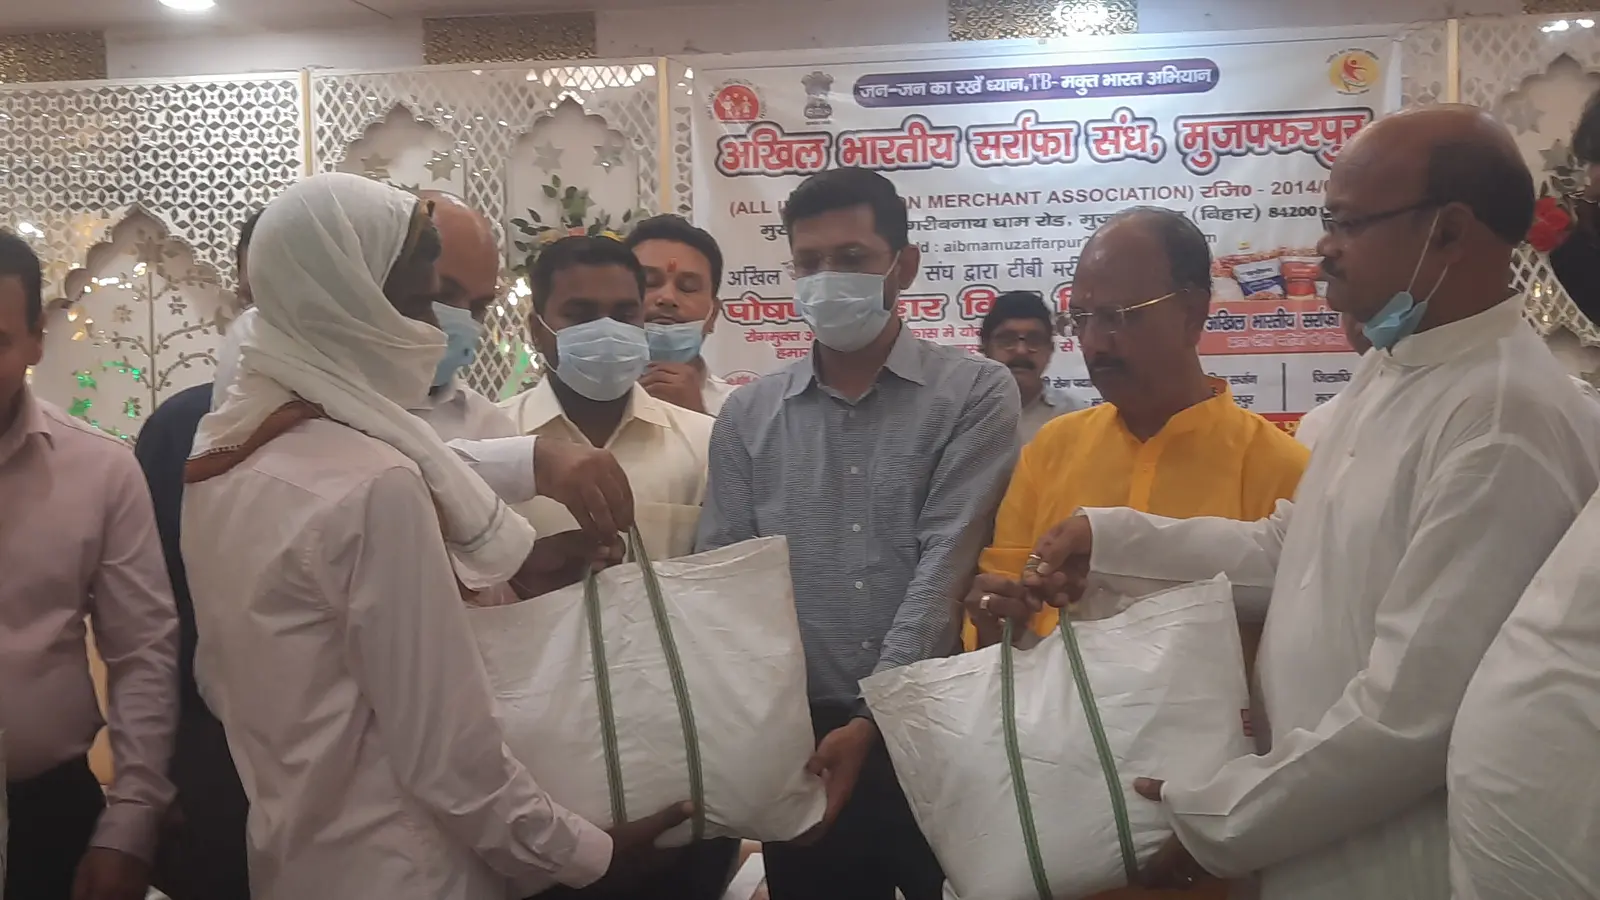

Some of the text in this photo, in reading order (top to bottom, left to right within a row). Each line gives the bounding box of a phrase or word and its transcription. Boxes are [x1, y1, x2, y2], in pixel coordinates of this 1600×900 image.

[859, 83, 927, 98] जन-जन
[929, 81, 953, 95] का
[1102, 72, 1144, 87] भारत
[1147, 65, 1212, 85] अभियान
[719, 124, 830, 173] अखिल
[840, 119, 957, 167] भारतीय
[970, 114, 1076, 163] सर्राफा
[730, 201, 772, 218] (ALL
[928, 191, 1041, 209] MERCHANT
[1046, 185, 1194, 204] ASSOCIATION)
[943, 236, 1090, 253] aibmamuzaffarpur
[727, 266, 782, 286] अखिल
[963, 263, 999, 282] द्वारा
[1006, 257, 1044, 278] टीबी
